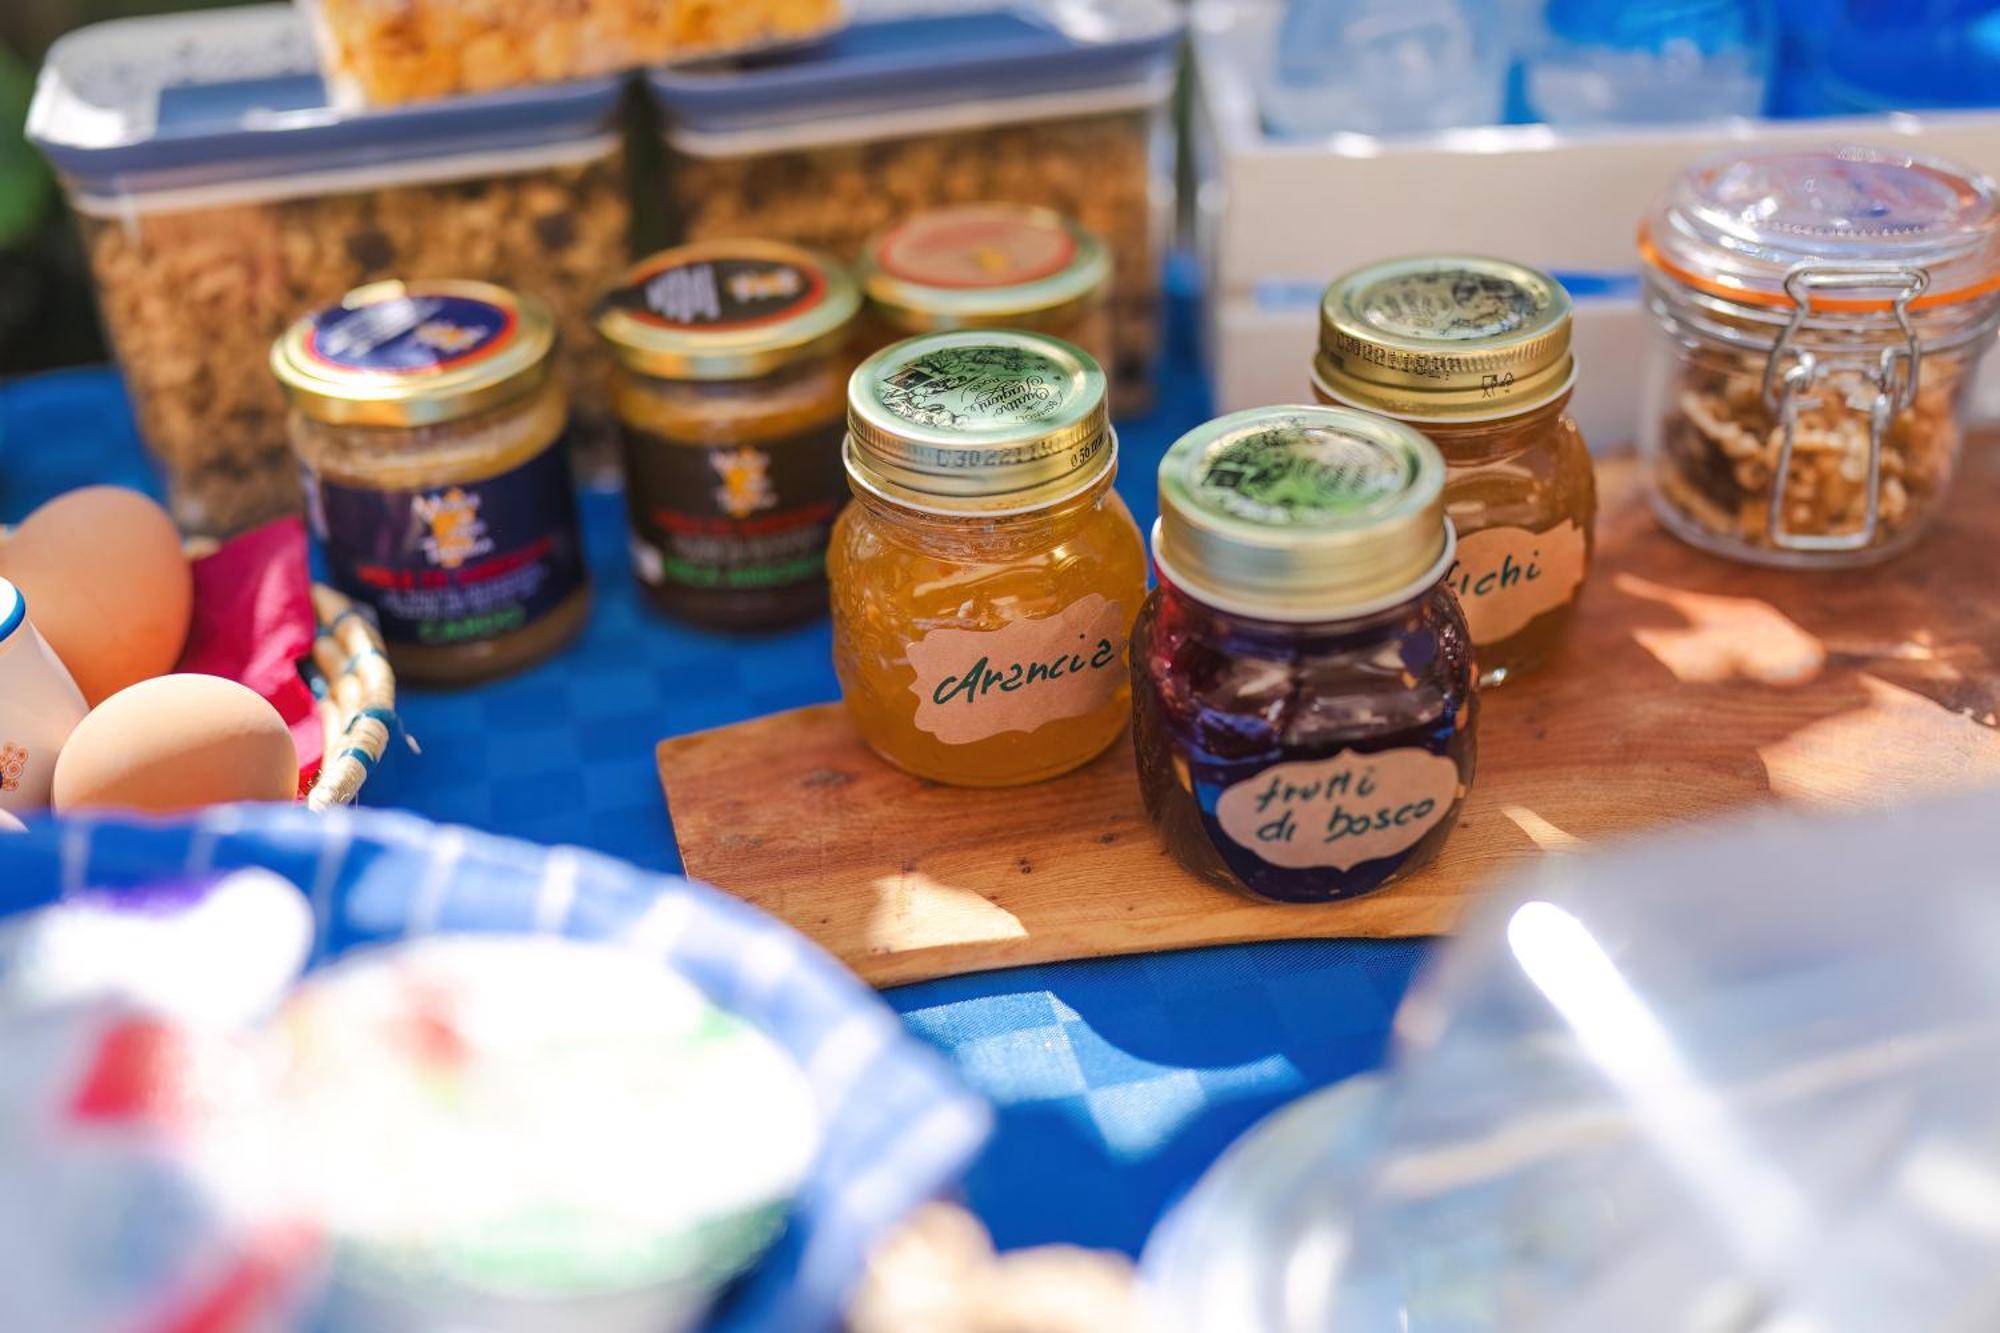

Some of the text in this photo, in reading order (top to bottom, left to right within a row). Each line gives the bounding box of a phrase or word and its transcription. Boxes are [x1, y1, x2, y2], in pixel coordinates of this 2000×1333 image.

[933, 633, 1115, 705] Arancia
[1256, 797, 1436, 844] di bosco
